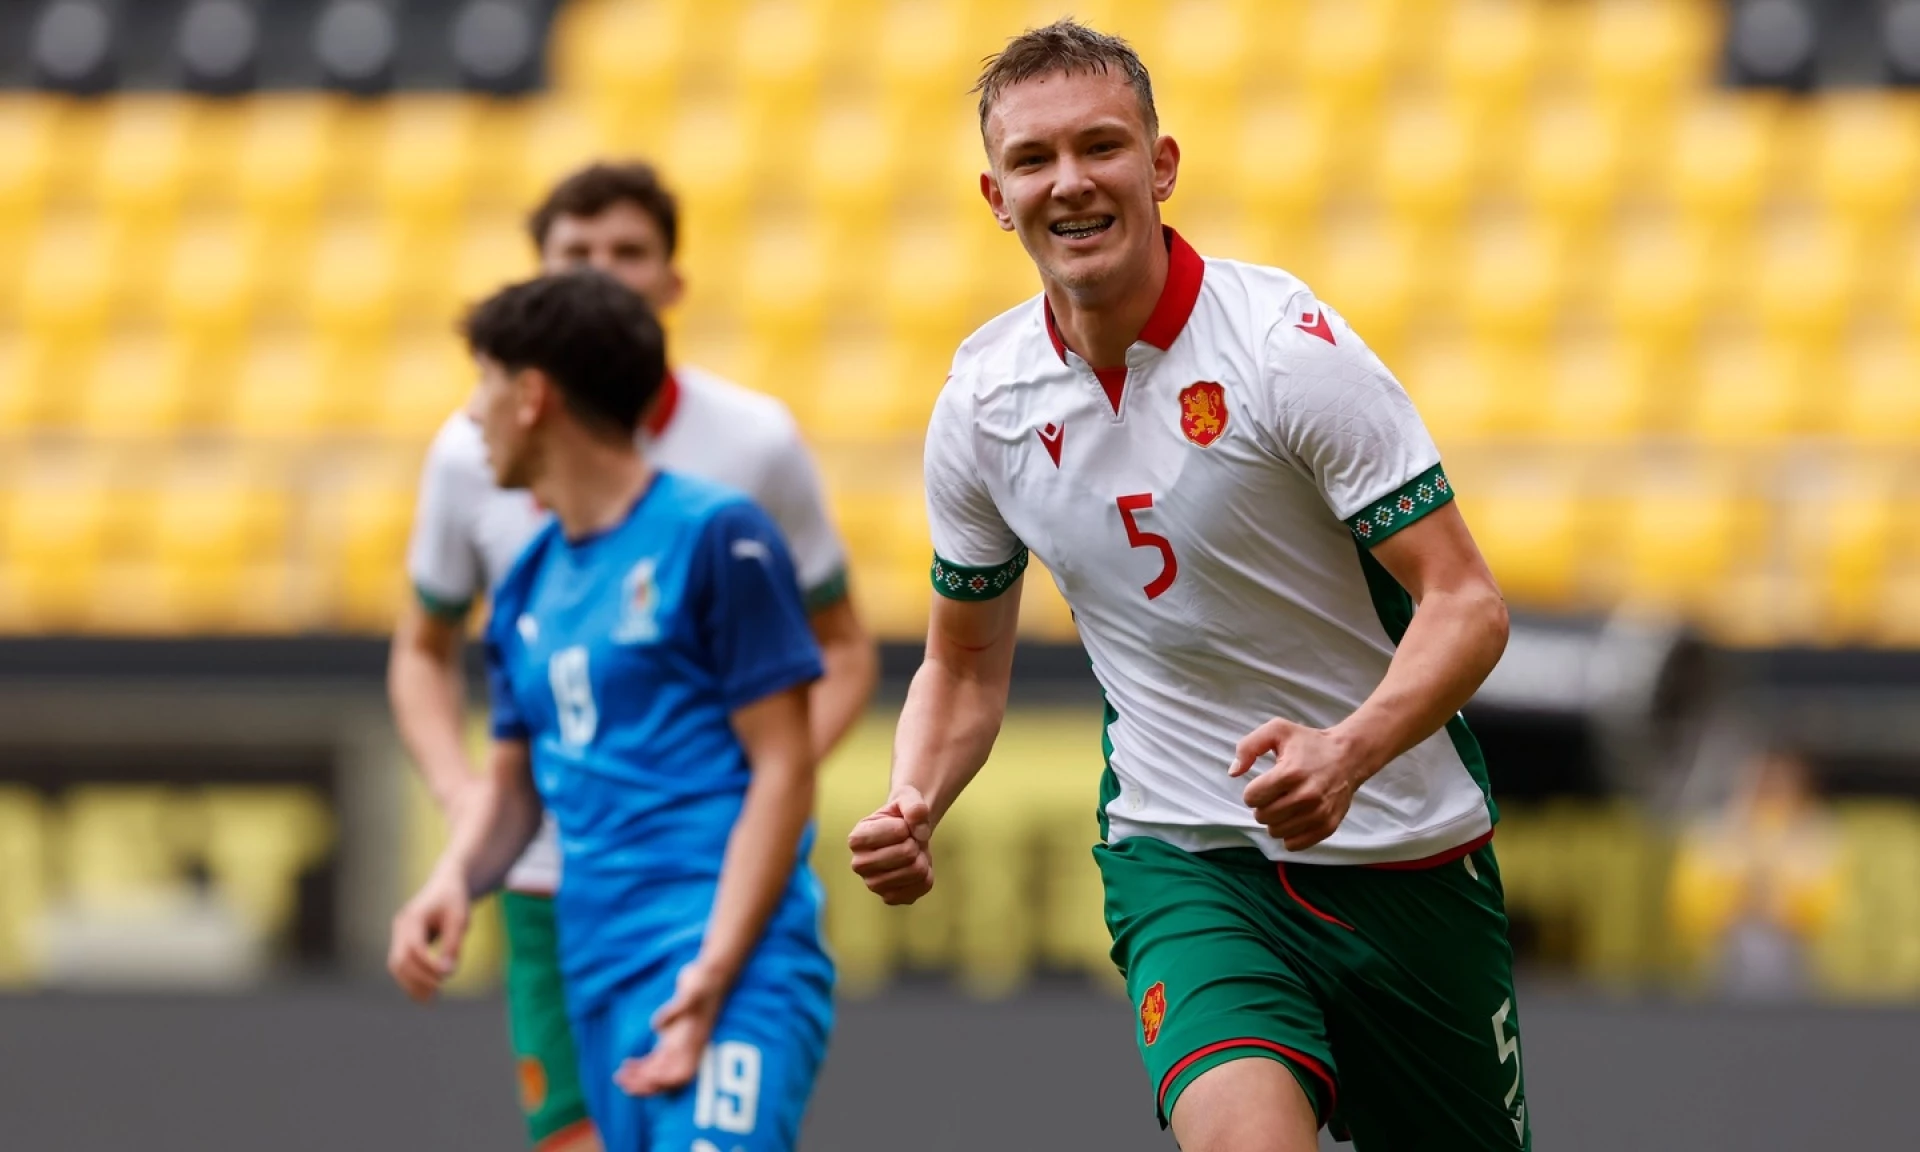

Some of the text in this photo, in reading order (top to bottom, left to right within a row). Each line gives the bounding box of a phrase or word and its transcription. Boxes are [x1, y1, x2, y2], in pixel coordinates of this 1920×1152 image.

[1116, 492, 1177, 600] 5
[548, 645, 597, 746] 19
[694, 1040, 762, 1135] 19
[1491, 997, 1520, 1110] 5
